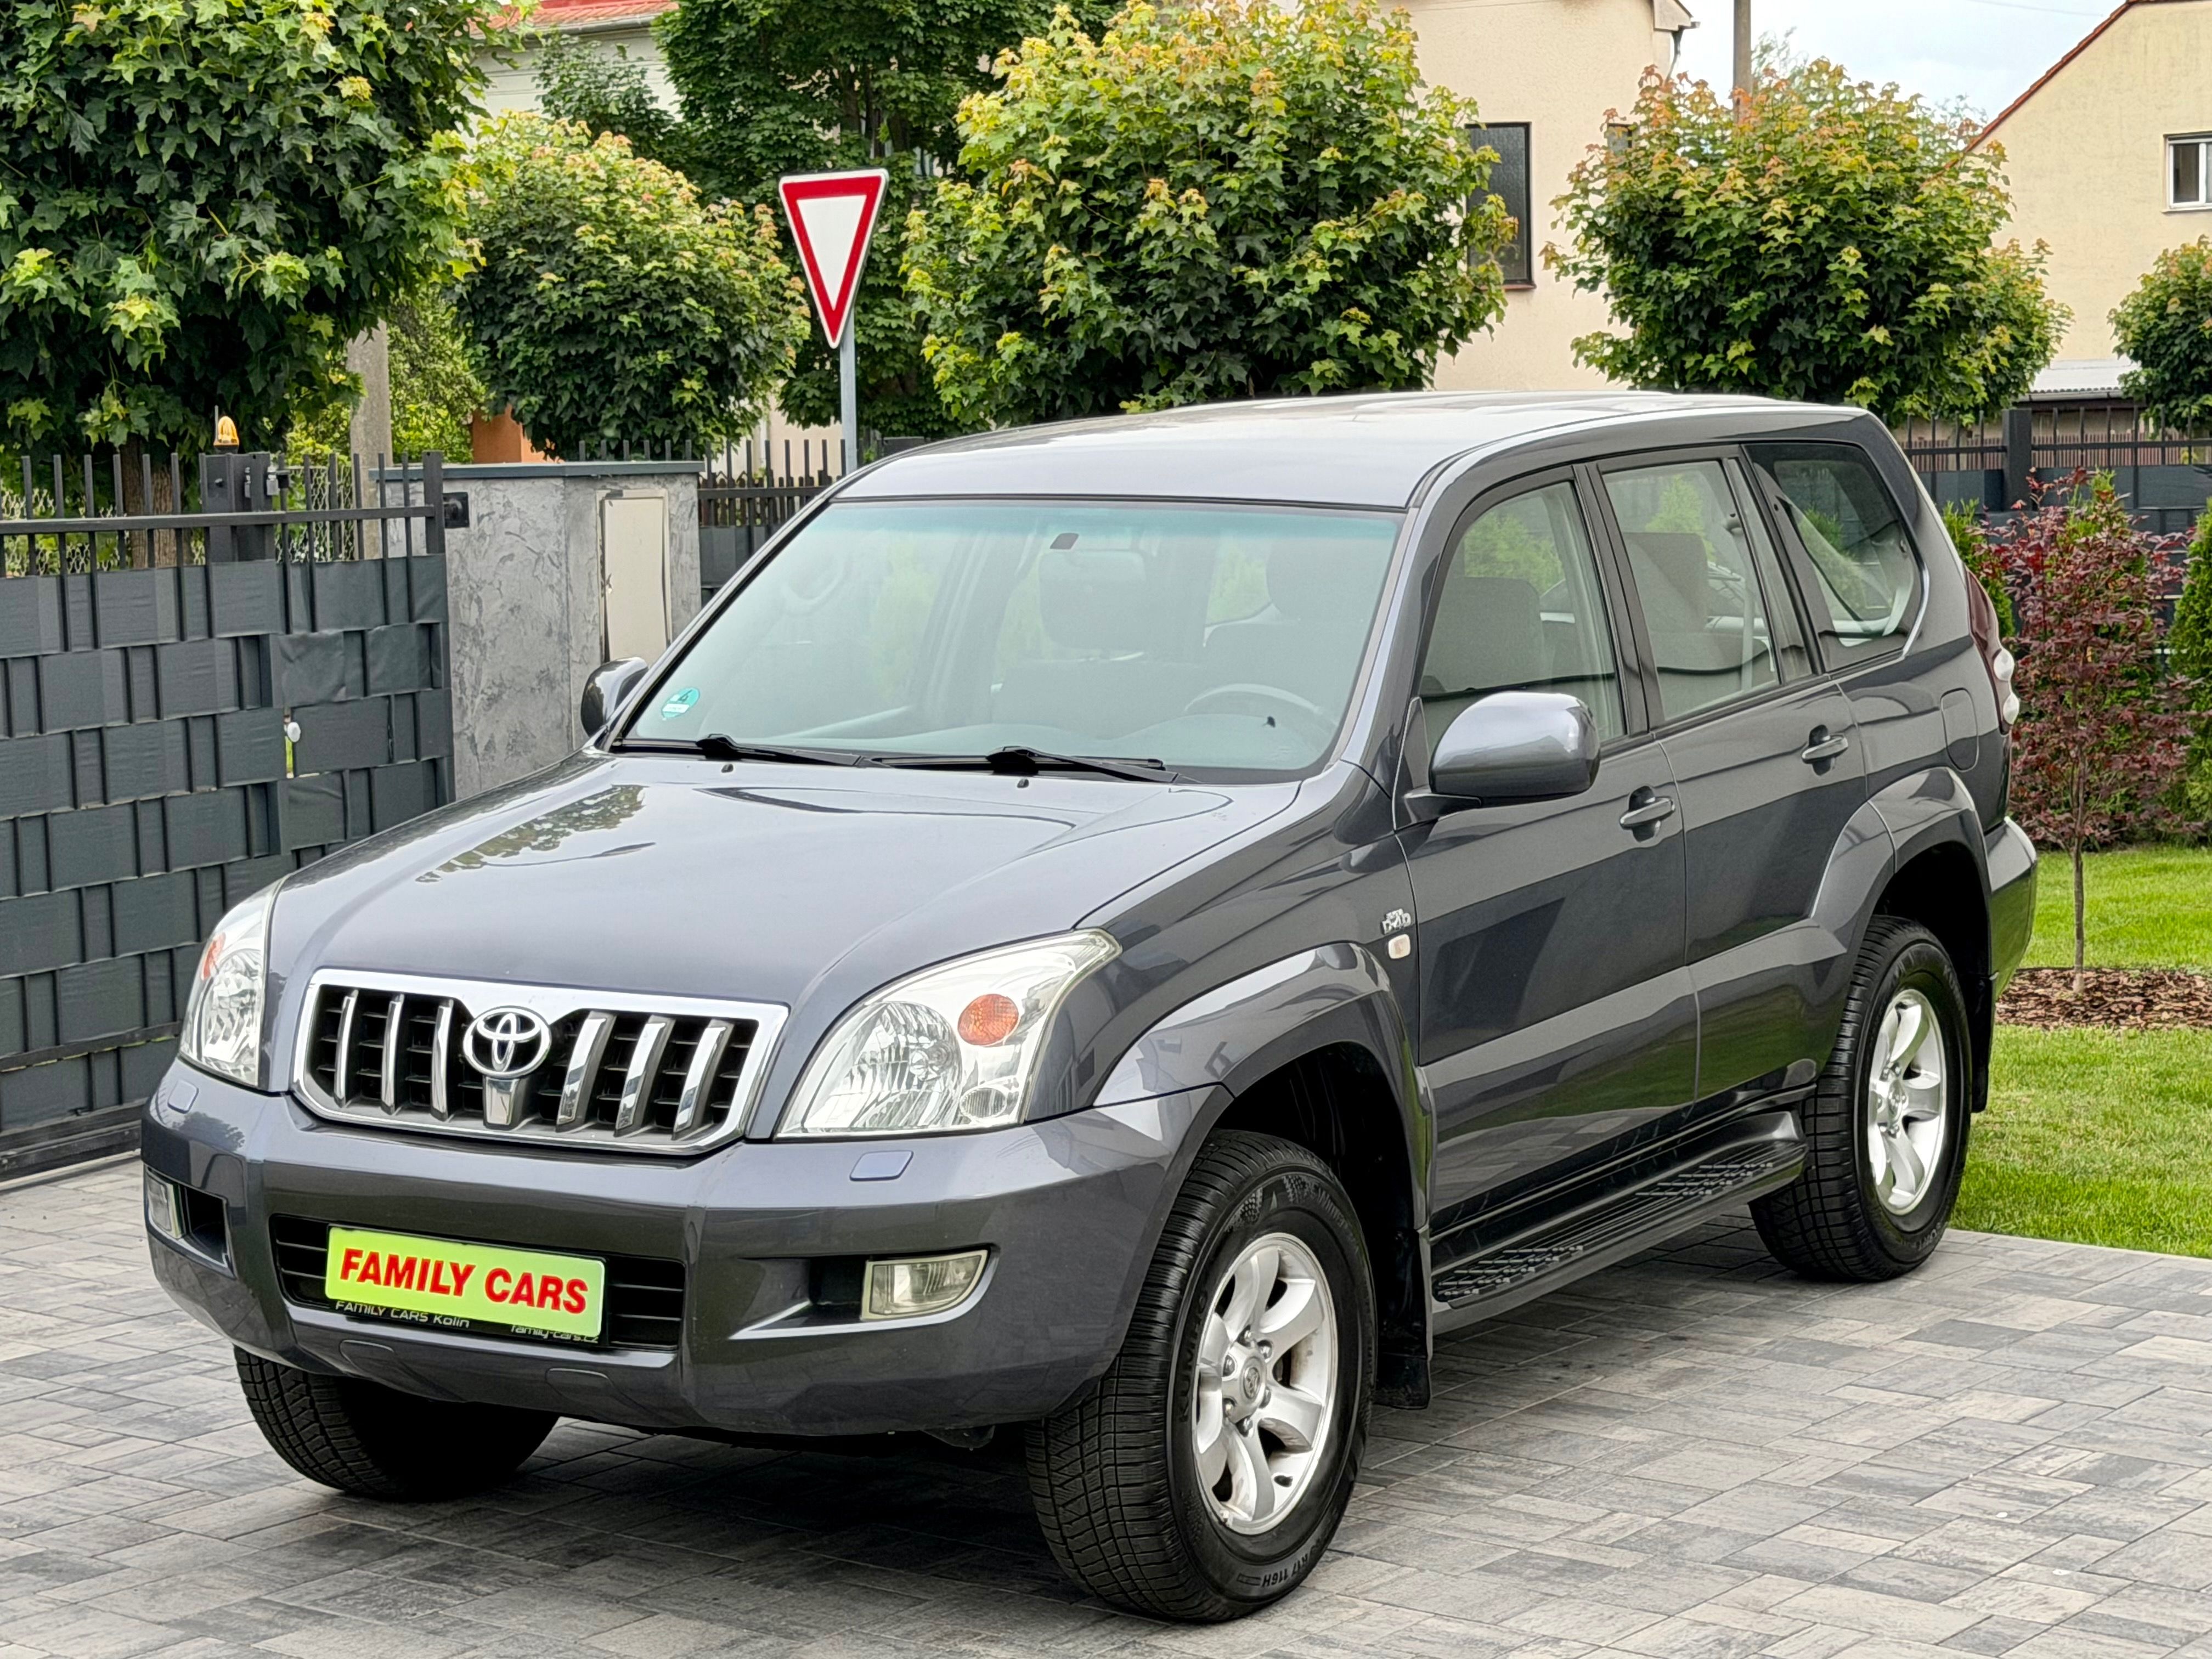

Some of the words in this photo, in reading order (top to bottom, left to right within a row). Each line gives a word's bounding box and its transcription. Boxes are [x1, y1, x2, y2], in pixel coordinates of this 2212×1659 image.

[339, 1248, 476, 1297] FAMILY
[484, 1267, 589, 1314] CARS
[335, 1300, 386, 1317] FAMILY
[390, 1308, 429, 1323] CARS
[1261, 1568, 1288, 1587] 116H
